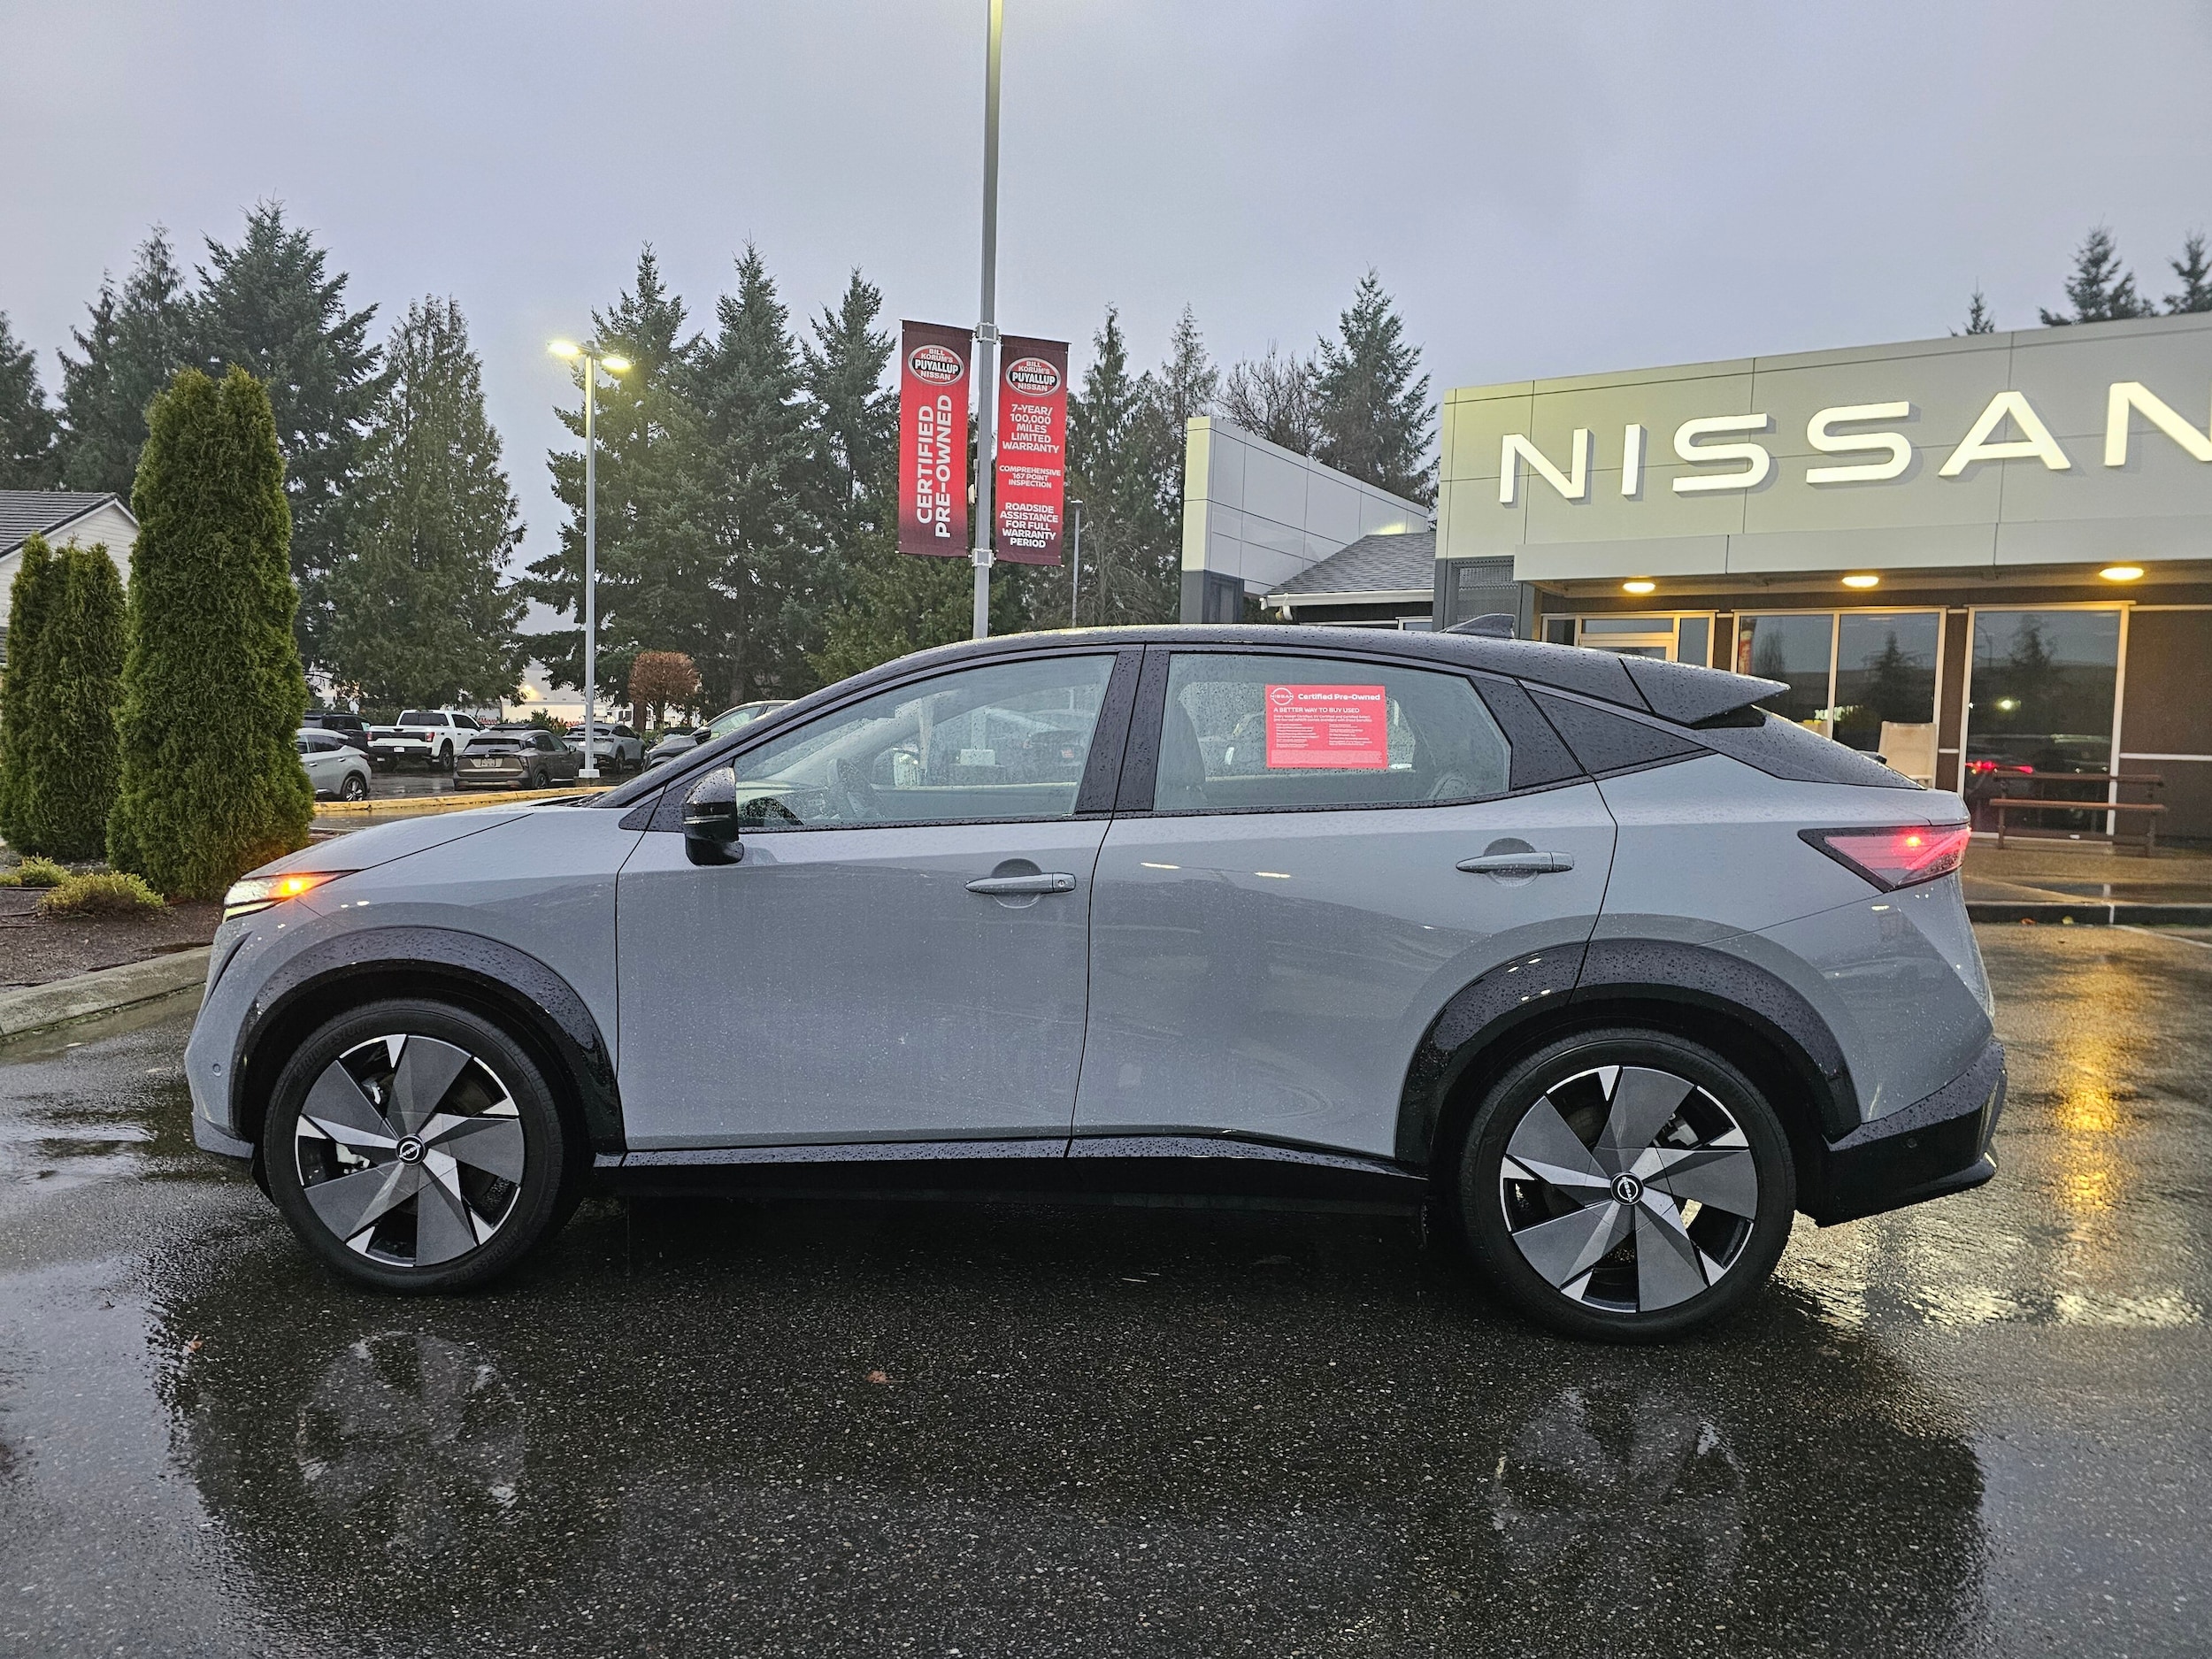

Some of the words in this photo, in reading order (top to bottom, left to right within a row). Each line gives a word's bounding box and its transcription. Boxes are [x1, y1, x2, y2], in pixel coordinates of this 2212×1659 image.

[920, 353, 954, 363] KORUM'S
[914, 359, 959, 374] PUYALLUP
[1018, 365, 1051, 374] KORUM'S
[920, 370, 951, 381] NISSAN
[1011, 372, 1056, 386] PUYALLUP
[1018, 382, 1048, 392] NISSAN
[1011, 403, 1053, 416] 7-YEAR/
[1010, 413, 1051, 425] 100,000
[1016, 423, 1047, 434] MILES
[1010, 432, 1051, 443] LIMITED
[1499, 381, 2212, 503] NISSAN
[1002, 441, 1060, 454] WARRANTY
[917, 405, 934, 524] CERTIFIED
[935, 395, 952, 538] PRE-OWNED
[999, 465, 1062, 476] COMPREHENSIVE
[1008, 479, 1052, 488] INSPECTION
[1005, 502, 1055, 514] ROADSIDE
[1000, 511, 1058, 523] ASSISTANCE
[1005, 519, 1026, 528] FOR
[1027, 521, 1051, 531] FULL
[1002, 527, 1056, 540] WARRANTY
[1010, 537, 1046, 549] PERIOD
